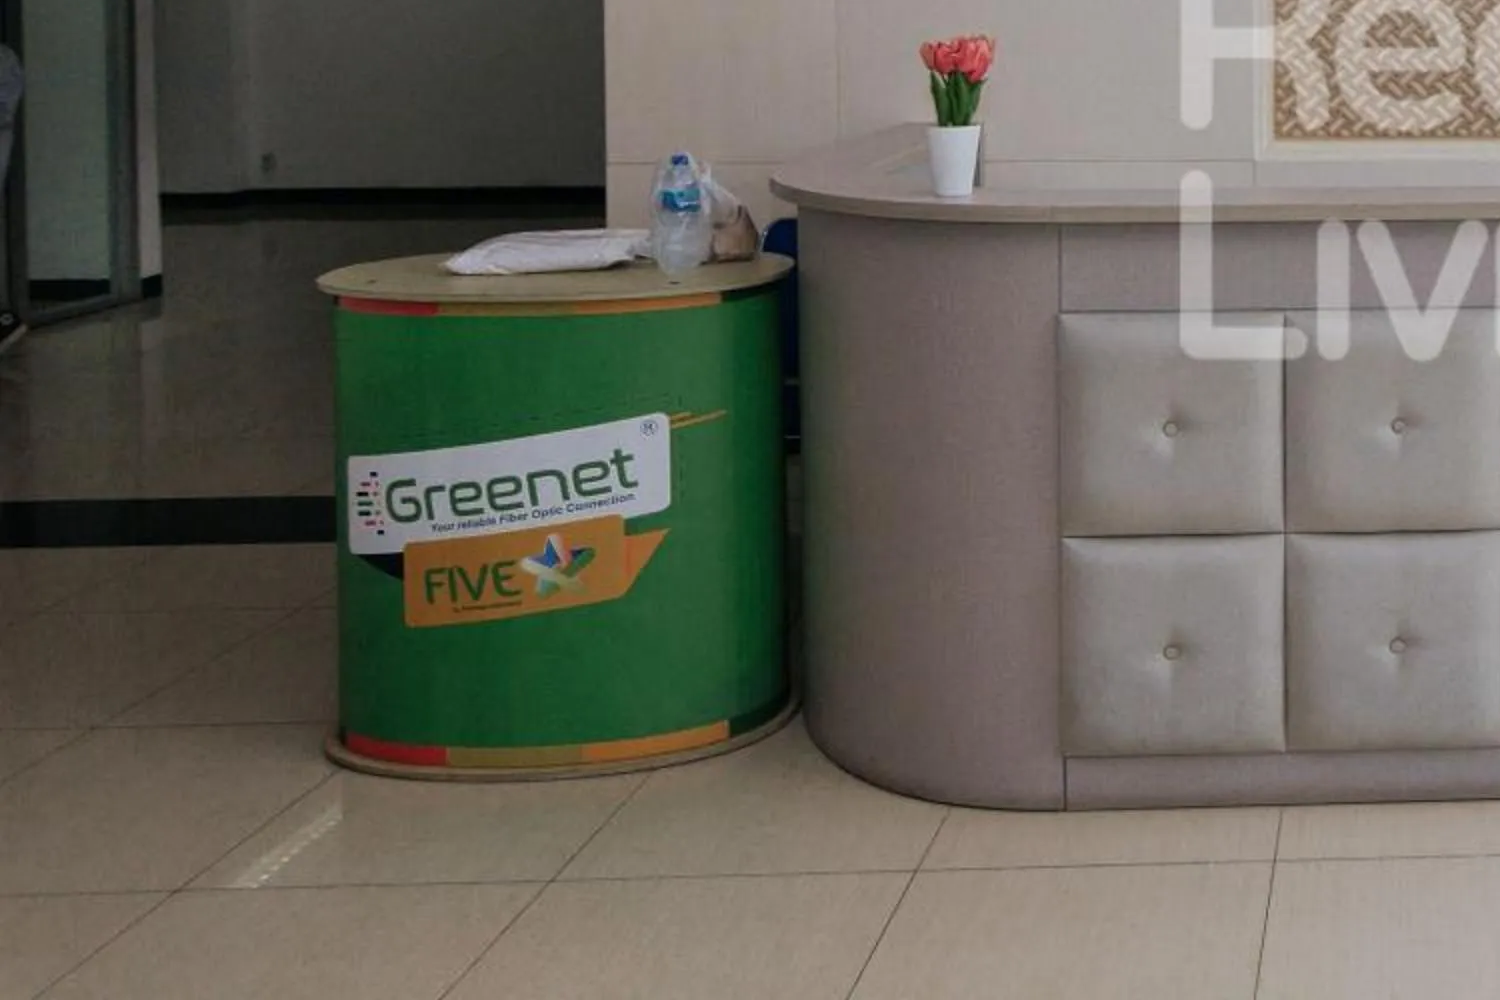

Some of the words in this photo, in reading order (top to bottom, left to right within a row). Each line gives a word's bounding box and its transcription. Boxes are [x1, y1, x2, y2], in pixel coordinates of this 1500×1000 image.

[385, 447, 639, 523] Greenet
[499, 512, 529, 525] Fiber
[531, 506, 563, 521] Optic
[423, 559, 523, 605] FIVE
